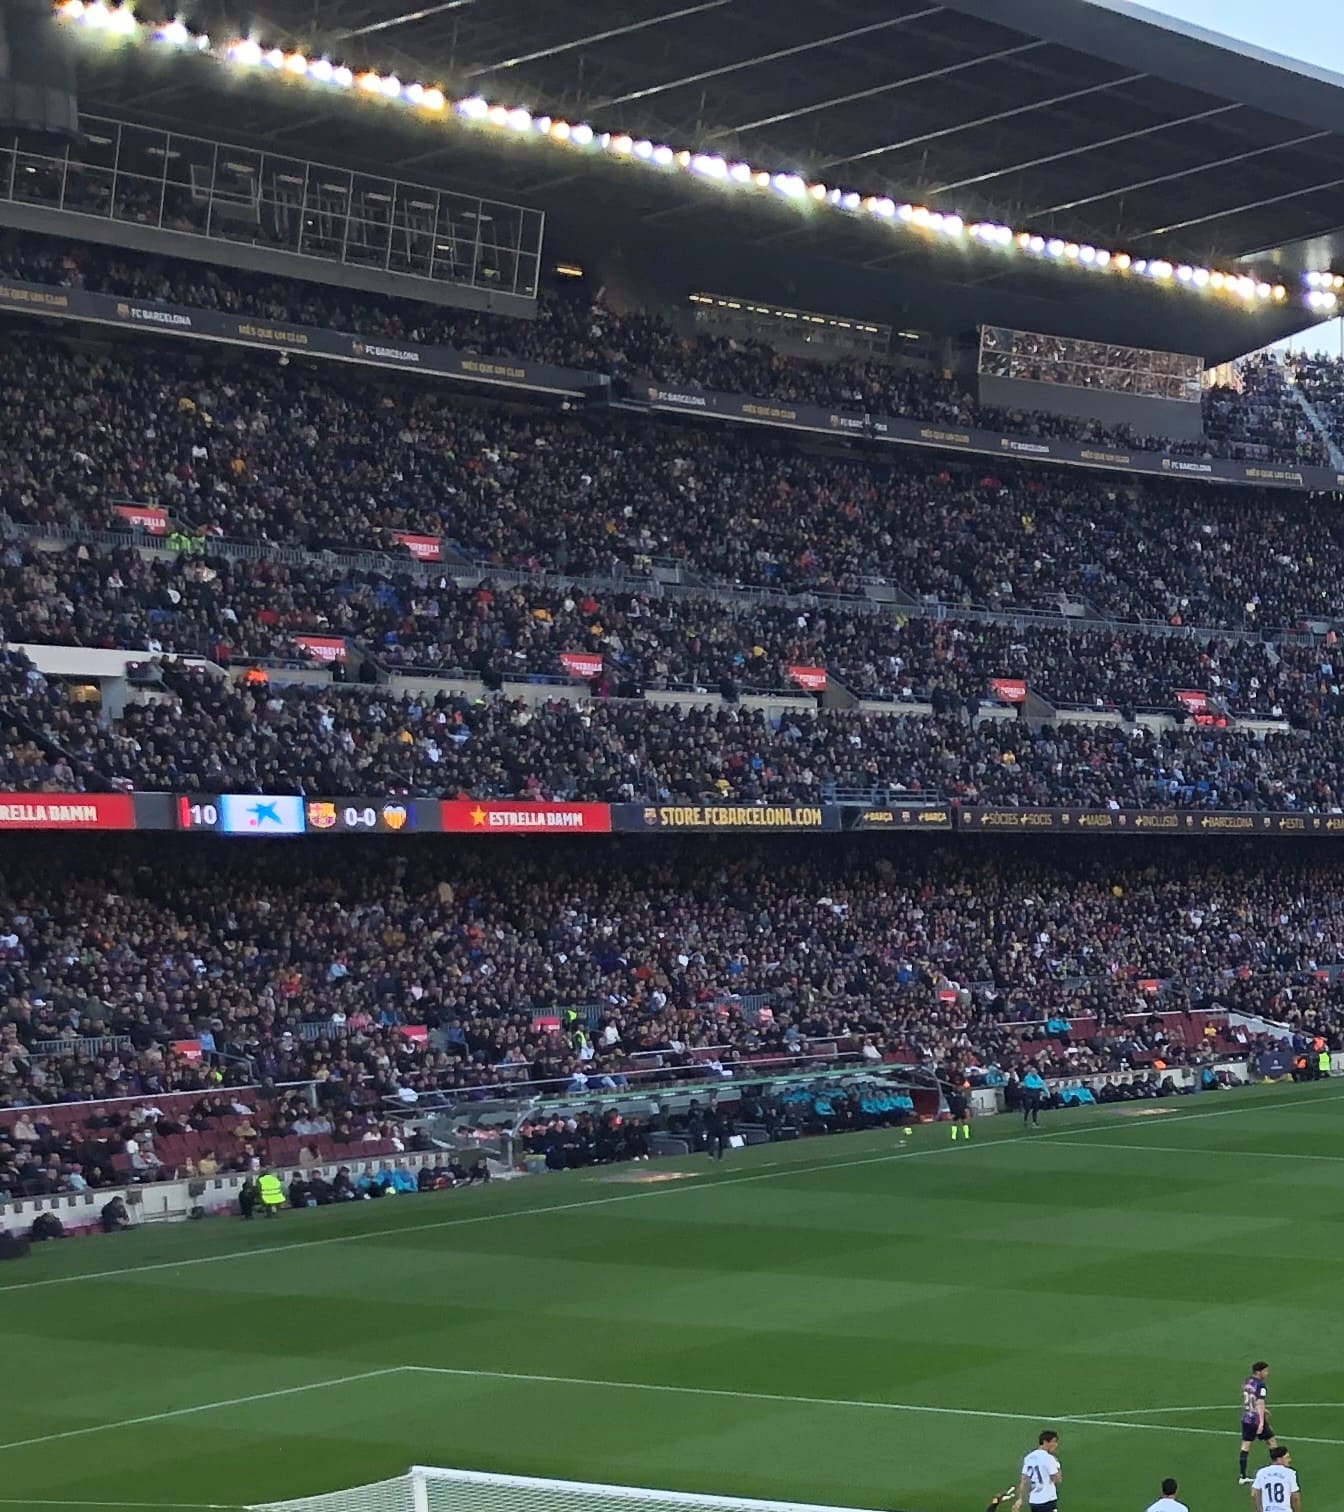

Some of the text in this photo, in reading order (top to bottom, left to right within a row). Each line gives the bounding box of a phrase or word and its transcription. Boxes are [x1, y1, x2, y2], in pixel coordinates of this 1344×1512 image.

[49, 805, 97, 822] DAMM
[344, 807, 377, 826] 0-0
[489, 811, 583, 827] ESTRELLA DAMM
[660, 807, 823, 827] STORE.FCBARCELONA.COM
[1264, 1482, 1285, 1504] 18
